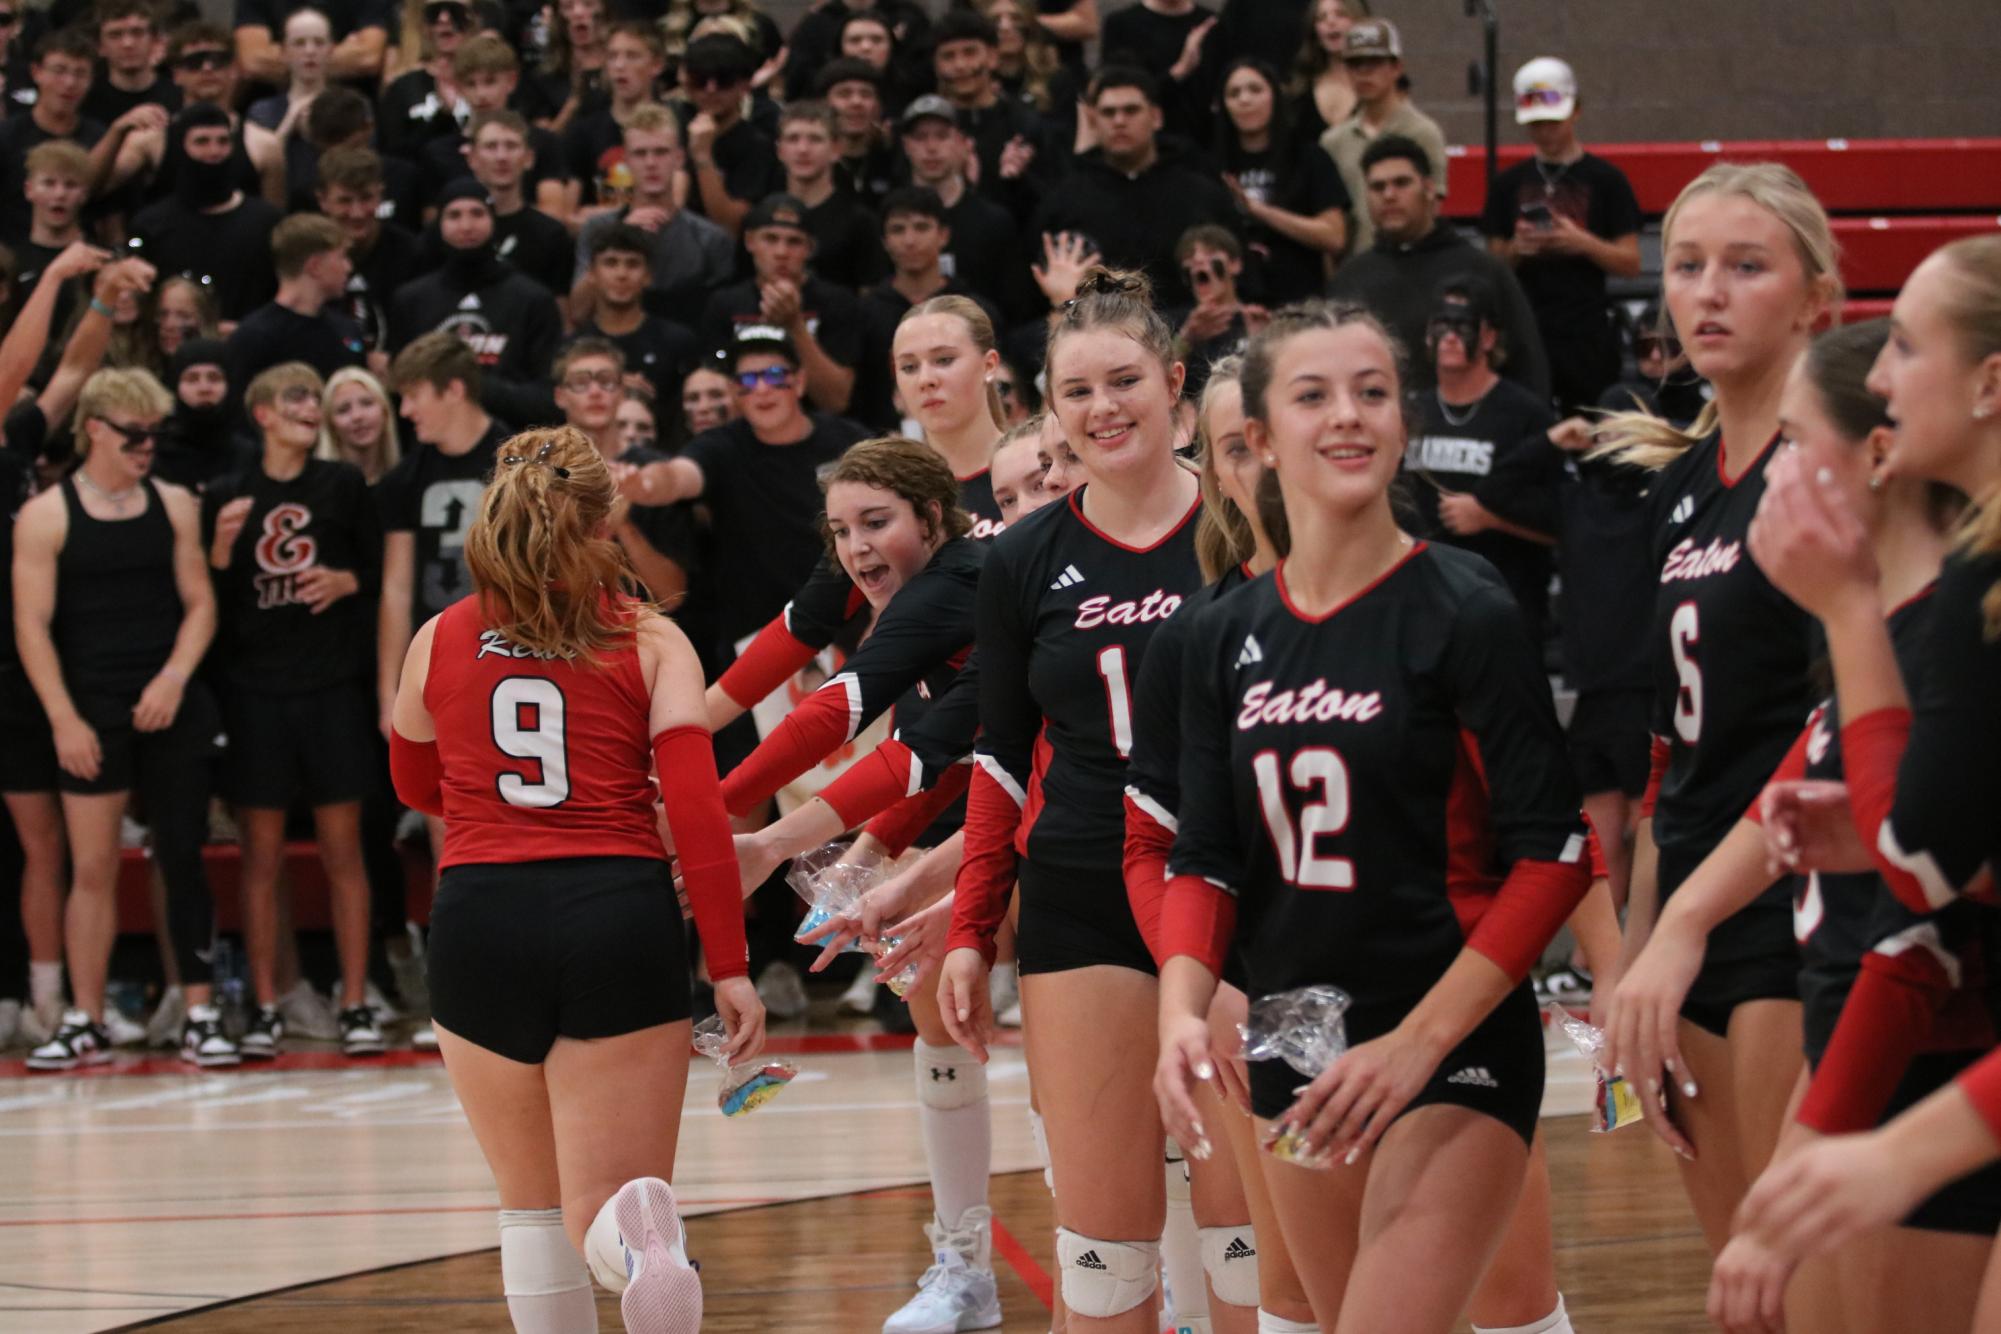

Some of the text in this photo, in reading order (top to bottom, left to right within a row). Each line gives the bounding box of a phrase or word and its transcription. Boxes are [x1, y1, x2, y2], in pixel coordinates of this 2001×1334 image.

[1659, 536, 1742, 584] Eaton
[1073, 587, 1183, 631] Eato
[1669, 597, 1704, 747] 6
[1096, 643, 1133, 761] 1
[1235, 677, 1384, 733] Eaton
[488, 673, 572, 810] 9
[1251, 746, 1356, 892] 12
[1076, 1259, 1107, 1271] adidas
[1224, 1248, 1257, 1262] adidas
